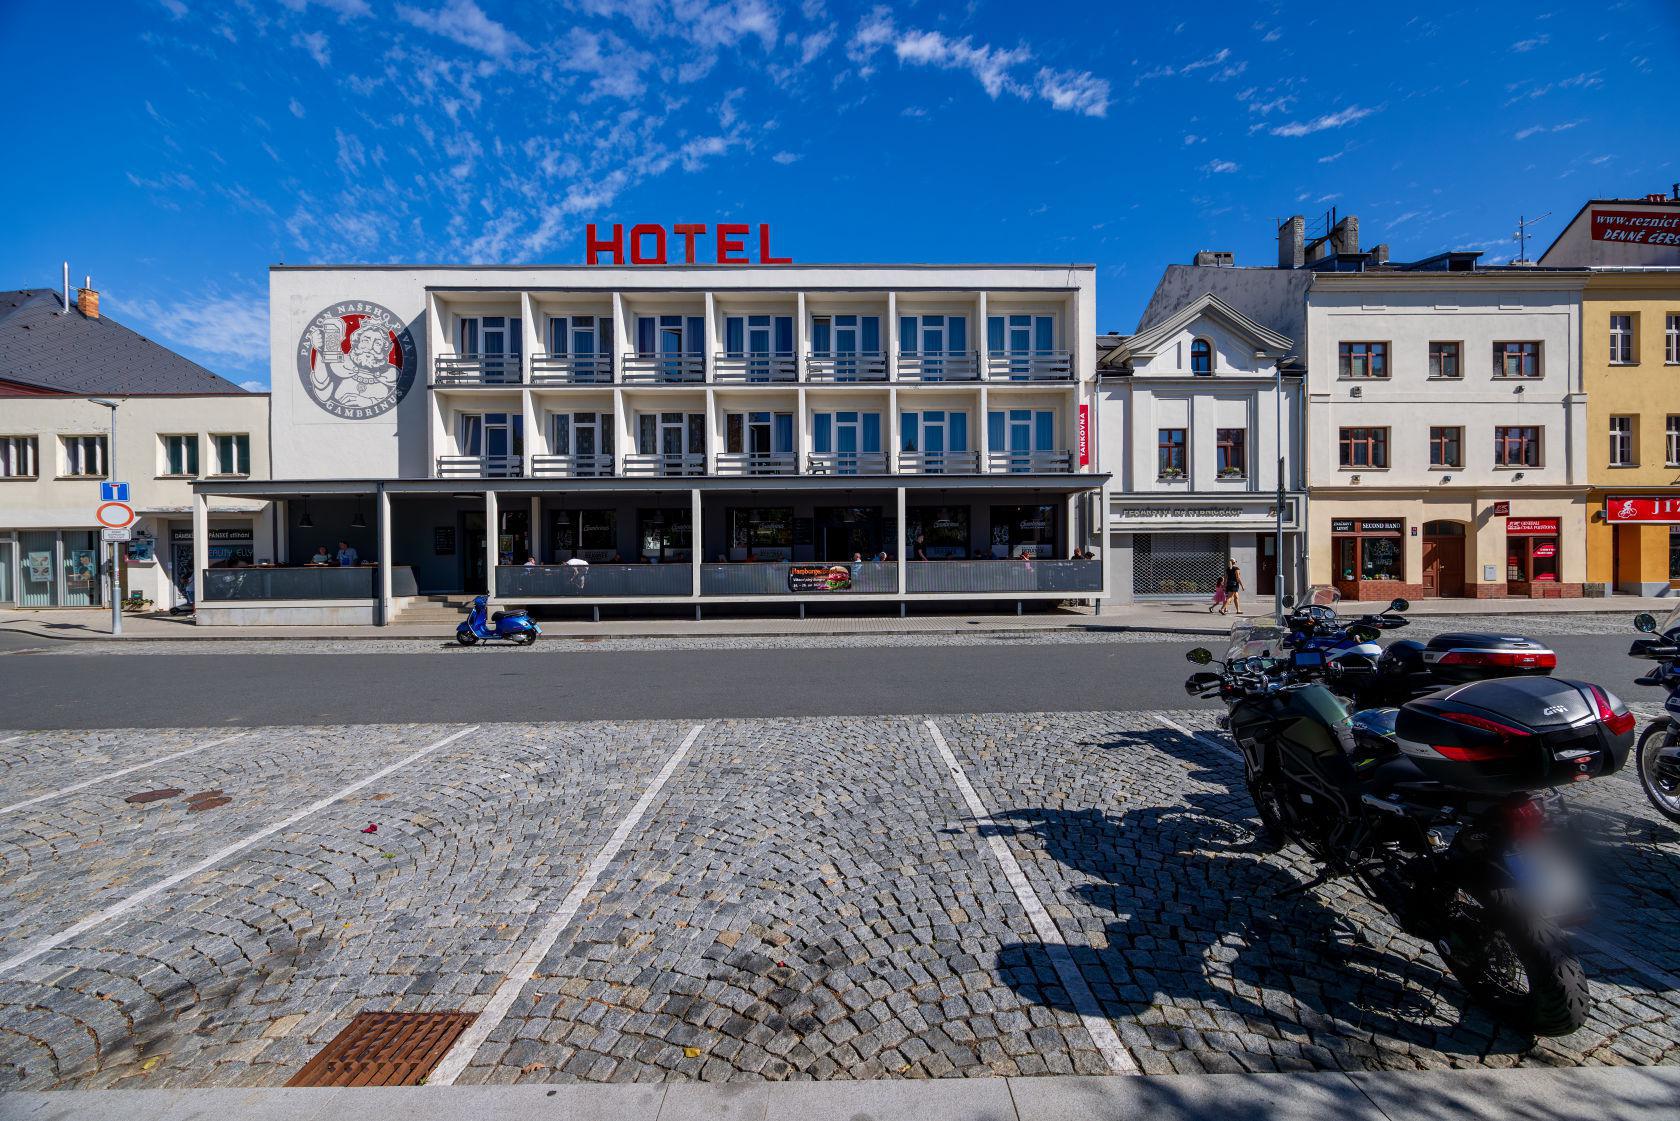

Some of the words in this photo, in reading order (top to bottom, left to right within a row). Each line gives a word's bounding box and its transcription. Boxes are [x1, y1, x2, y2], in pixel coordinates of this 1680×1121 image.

[586, 223, 792, 265] HOTEL
[301, 312, 333, 356] PATRON
[338, 303, 390, 324] NAŠEHO
[326, 391, 403, 418] GAMBRINUS
[1543, 705, 1569, 716] GIVI
